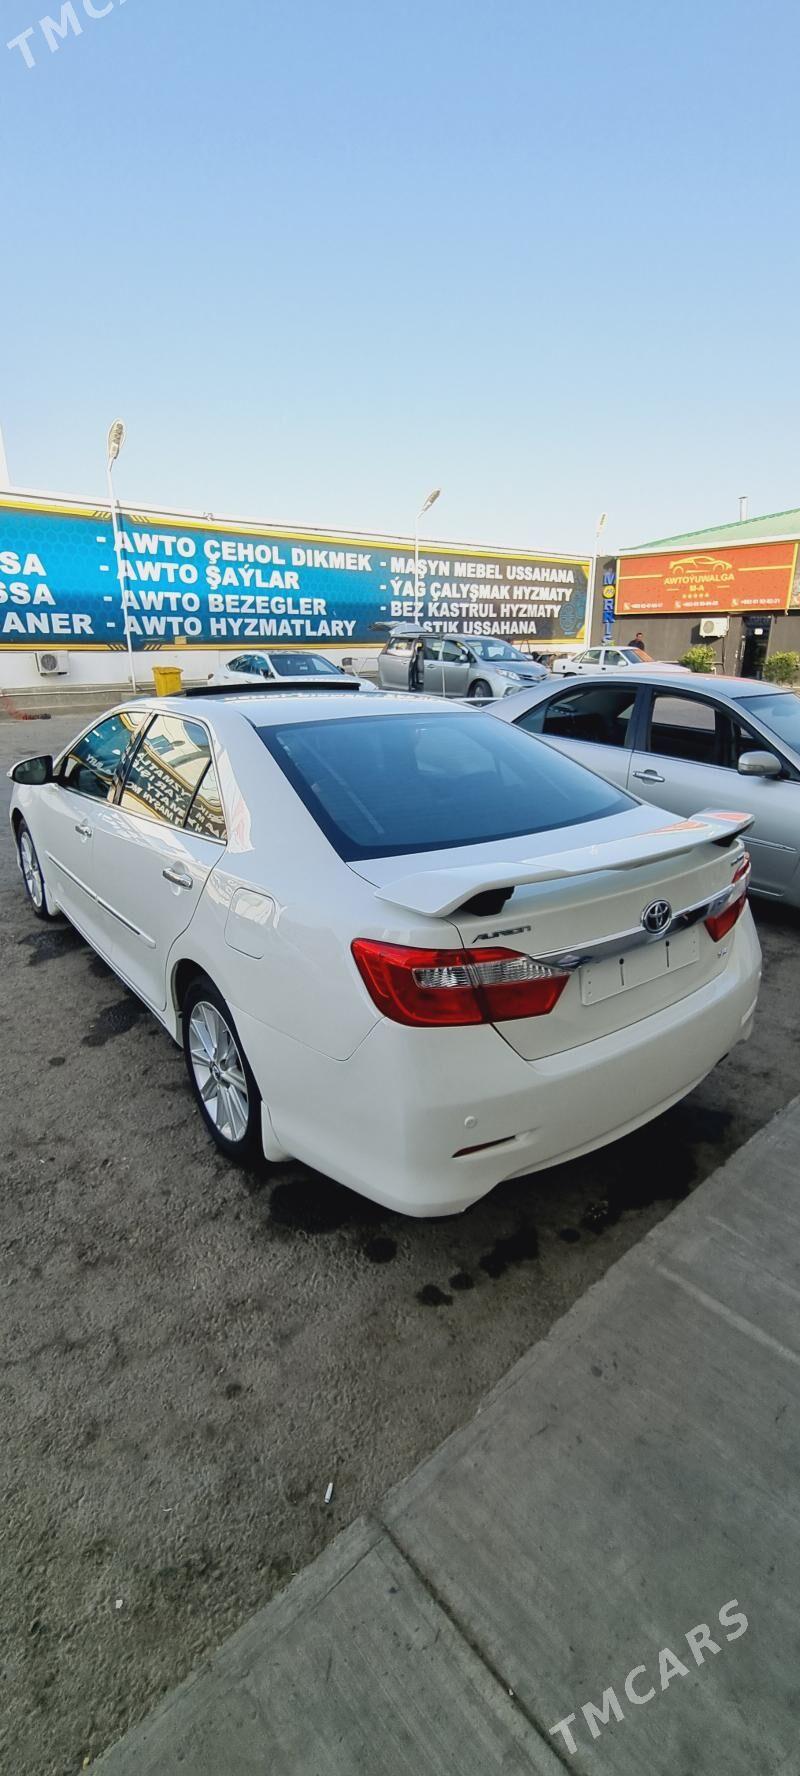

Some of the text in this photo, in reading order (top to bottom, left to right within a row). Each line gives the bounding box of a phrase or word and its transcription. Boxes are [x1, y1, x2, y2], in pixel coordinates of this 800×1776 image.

[114, 531, 196, 558] AWTO
[203, 539, 286, 565] ÇEHOL
[291, 548, 373, 573] DIKMEK
[117, 560, 198, 584] AWTO
[205, 564, 300, 590] ŞAÝLAR
[390, 557, 450, 578] MAŞYN
[453, 561, 503, 580] MEBEL
[506, 566, 575, 584] USSAHANA
[121, 590, 200, 612] AWTO
[208, 594, 327, 616] BEZEGLER
[431, 583, 510, 602] ÇALYŞMAK
[512, 586, 573, 602] HYZMATY
[390, 602, 424, 617] BEZ
[428, 603, 497, 618] KASTRUL
[501, 605, 562, 618] HYZMATY
[123, 616, 202, 636] AWTO
[211, 617, 357, 637] HYZMATLARY
[463, 621, 537, 635] USSAHANA
